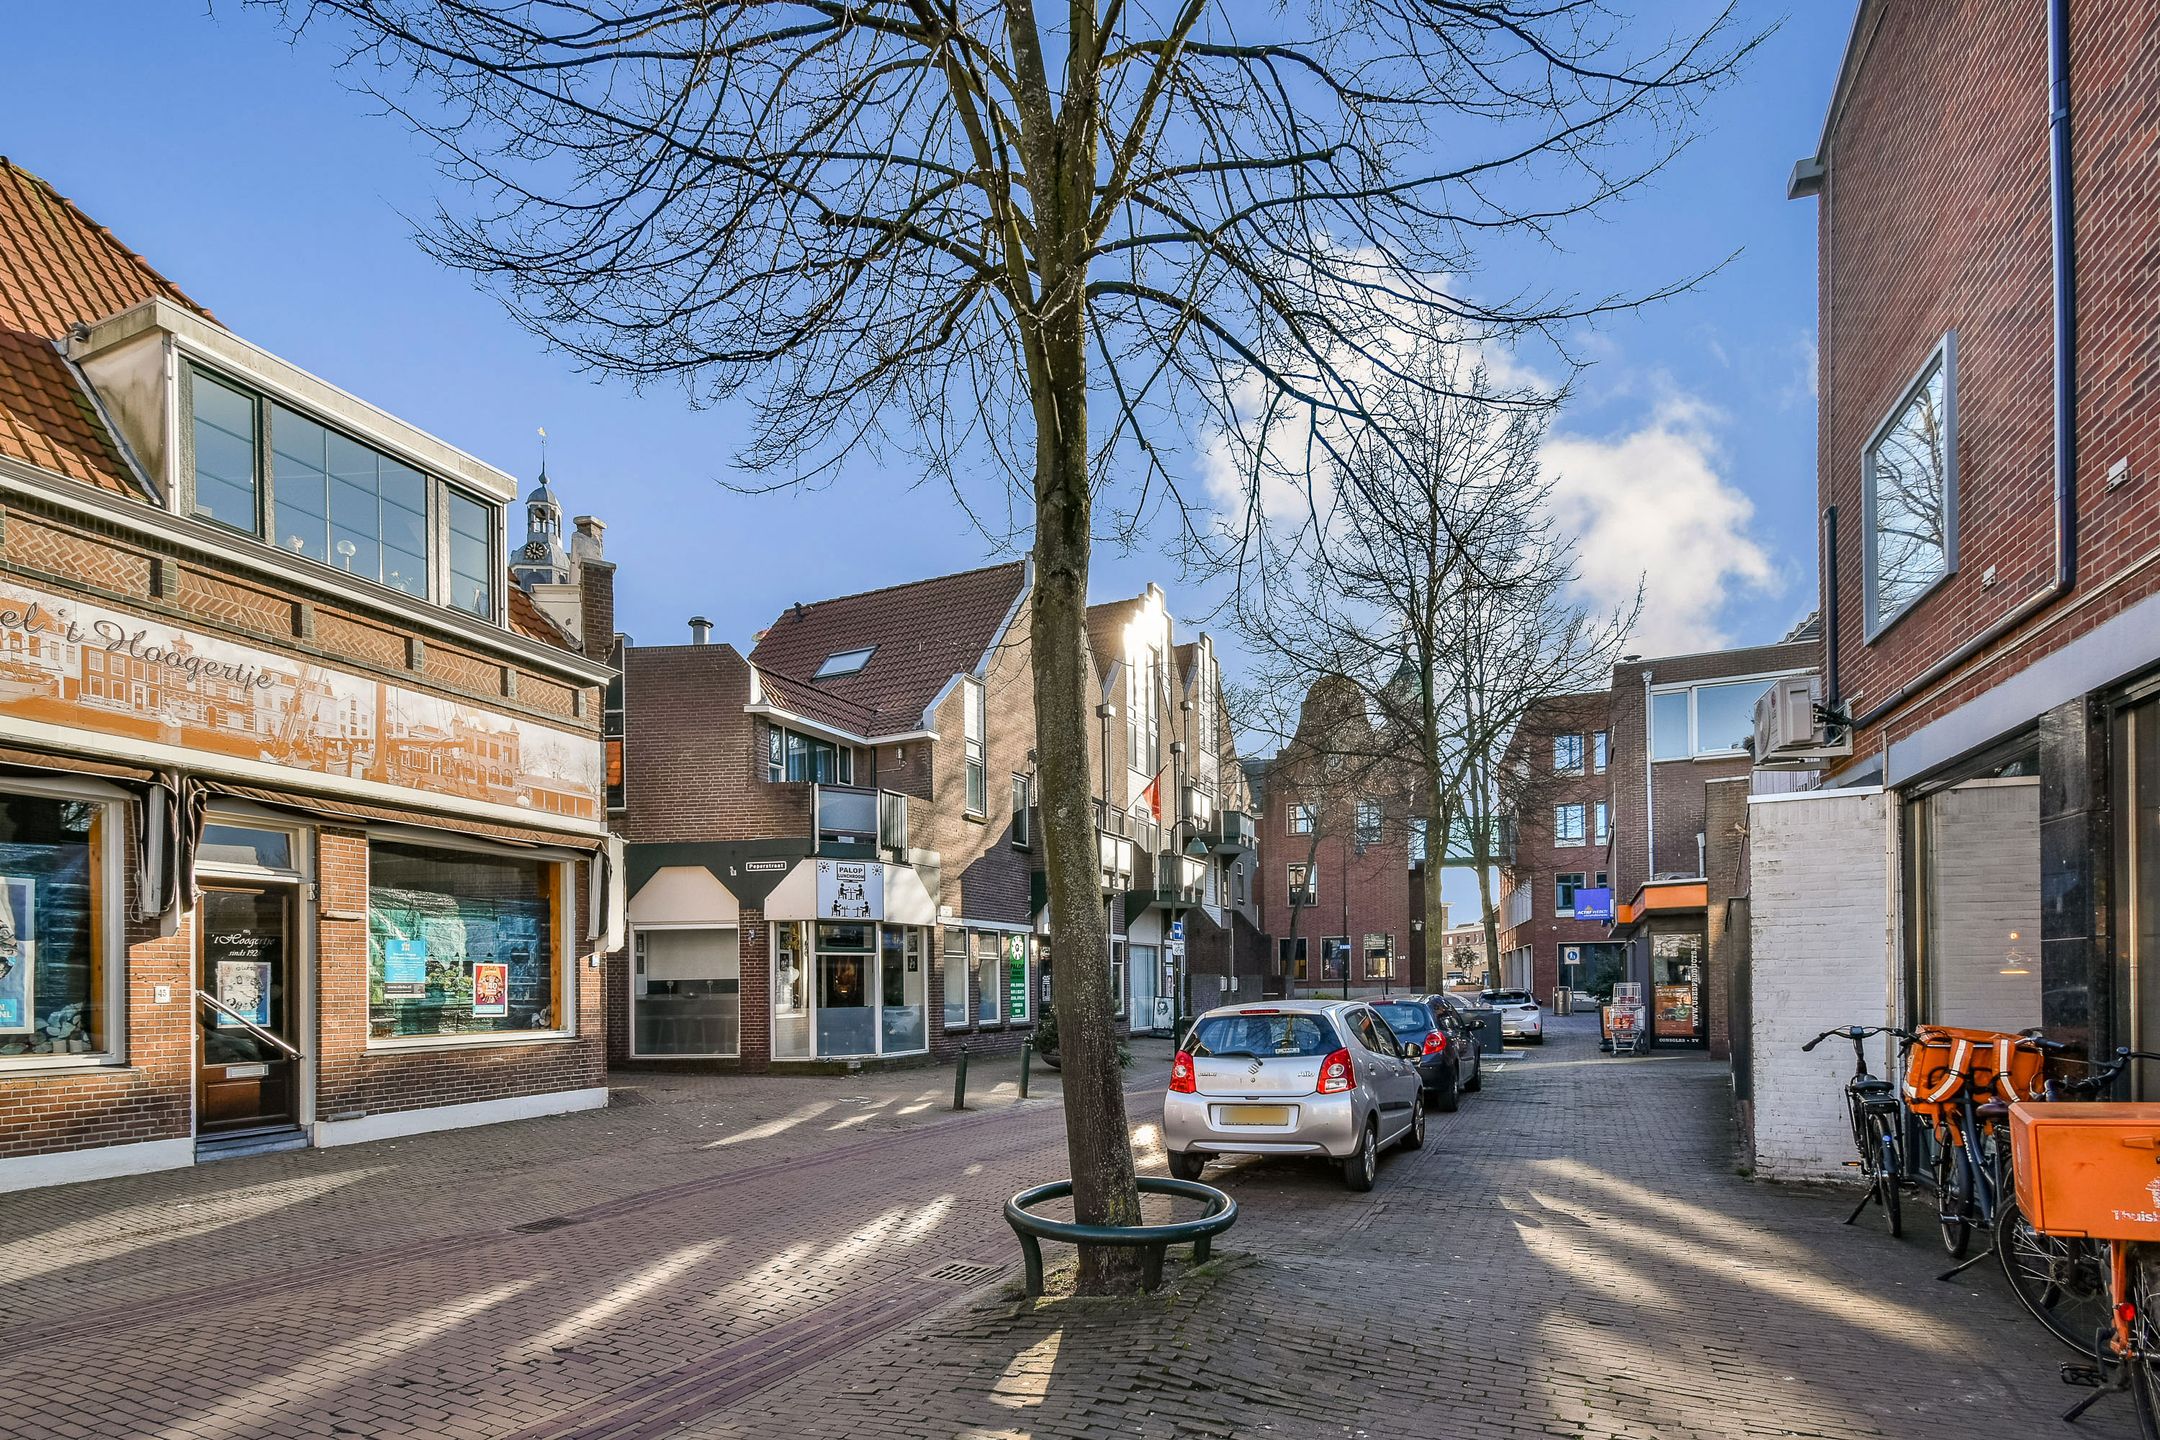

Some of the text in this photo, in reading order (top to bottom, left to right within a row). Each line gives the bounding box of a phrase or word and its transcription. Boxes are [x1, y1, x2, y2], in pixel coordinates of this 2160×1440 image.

[93, 619, 276, 692] Hoogertje
[839, 866, 864, 874] PALOP
[219, 933, 276, 948] Hoogertje
[228, 948, 246, 957] sinds
[1690, 938, 1699, 1027] WWW.USEDPRODUCTS.NL
